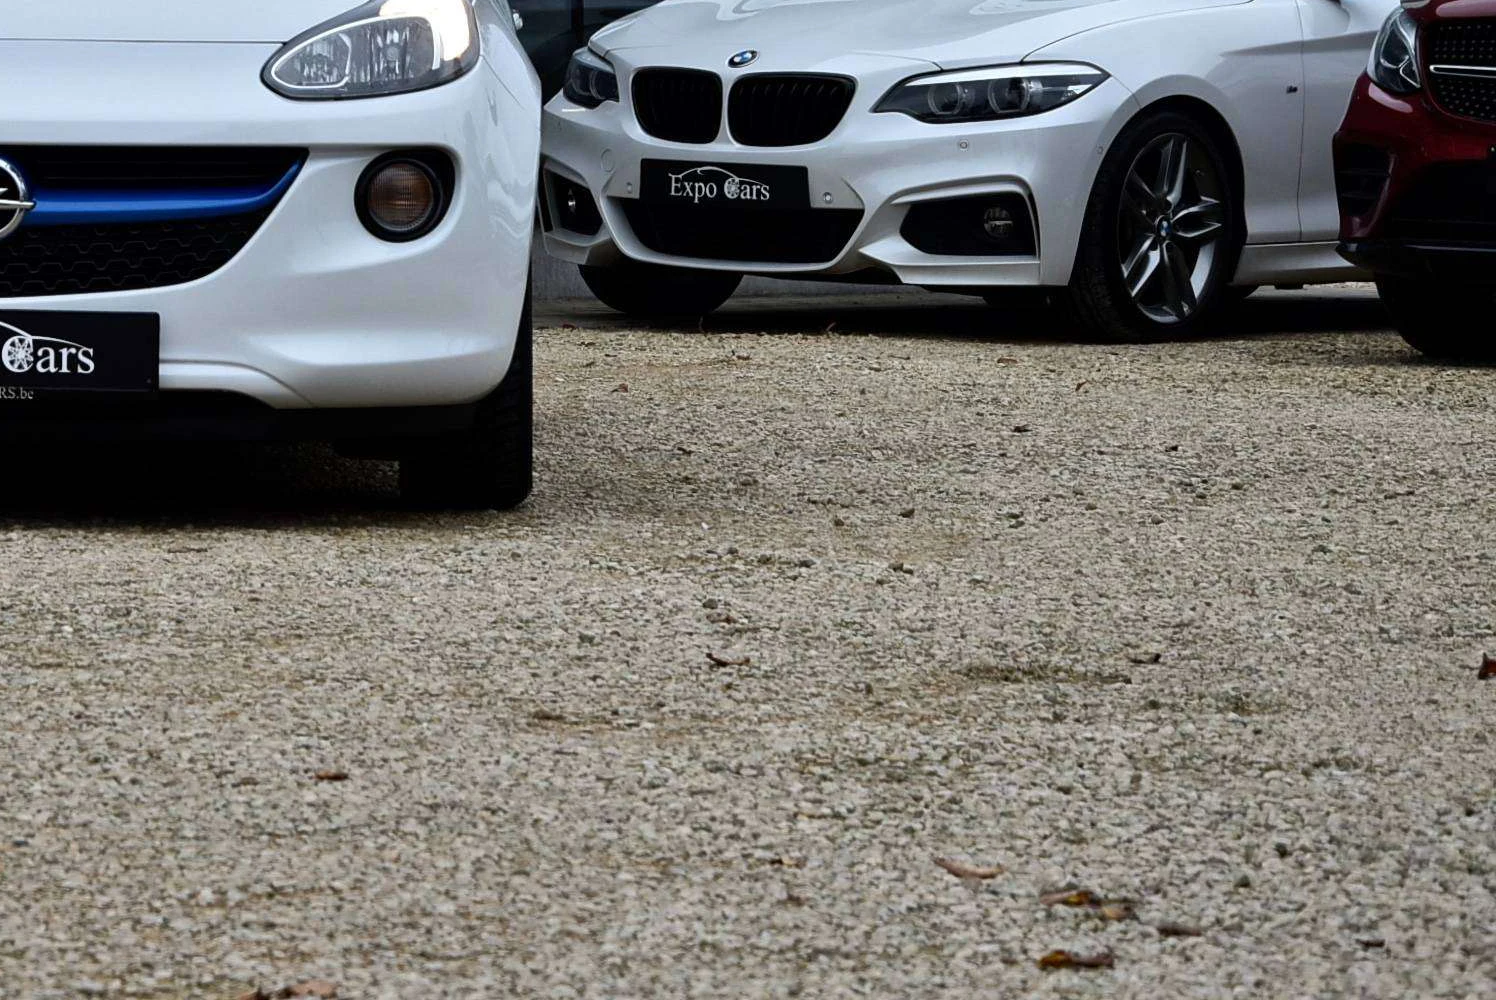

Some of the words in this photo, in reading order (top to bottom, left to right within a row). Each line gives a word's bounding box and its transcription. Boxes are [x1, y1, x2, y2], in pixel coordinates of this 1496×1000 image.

[668, 173, 717, 203] Expo
[724, 177, 770, 201] Cars
[1, 335, 96, 375] Cars
